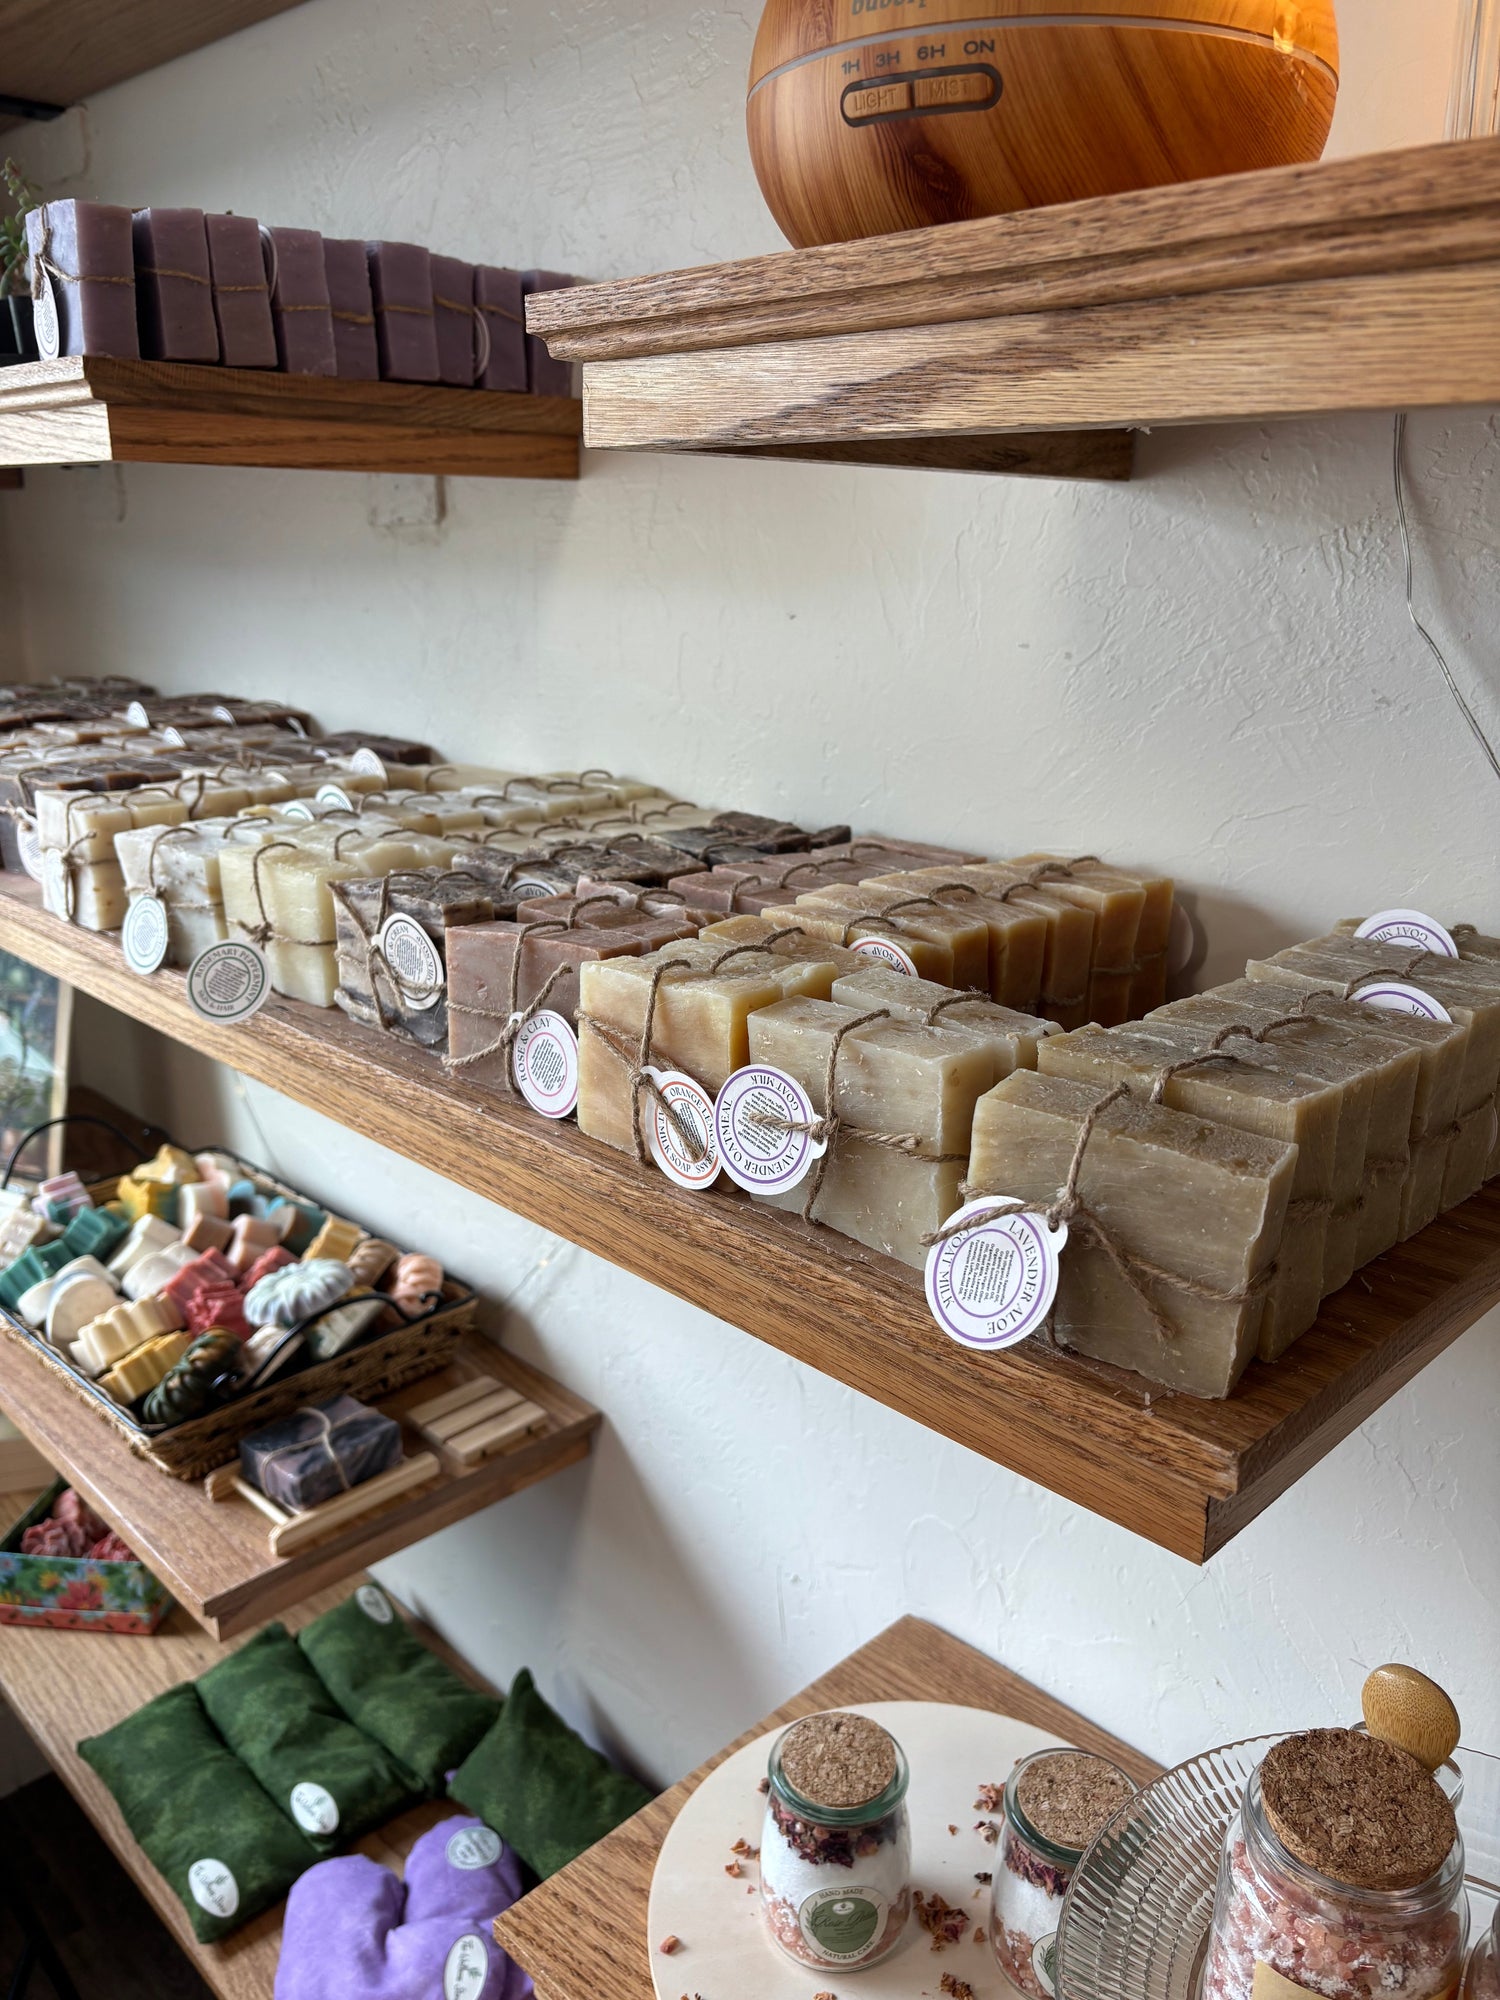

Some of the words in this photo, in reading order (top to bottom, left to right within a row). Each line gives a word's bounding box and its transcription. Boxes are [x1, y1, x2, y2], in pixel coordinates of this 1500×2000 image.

[841, 58, 860, 74] 1H
[876, 51, 900, 67] 3H
[917, 44, 945, 60] 6H
[964, 40, 995, 54] ON
[854, 88, 896, 111] LIGHT
[930, 79, 971, 98] MIST
[390, 925, 409, 941] CREAM
[1396, 926, 1428, 942] GOAT
[872, 946, 894, 961] SOAP
[527, 1016, 551, 1035] CLAY
[520, 1034, 529, 1045] &
[515, 1044, 527, 1082] ROSE
[750, 1074, 774, 1085] MILK
[669, 1087, 704, 1108] ORANGE
[774, 1082, 800, 1111] GOAT
[718, 1099, 742, 1163] OATMEAL
[658, 1125, 672, 1154] MILK
[669, 1152, 691, 1173] SOAP
[743, 1142, 800, 1176] LAVENDER
[943, 1229, 970, 1264] GOAT
[1008, 1220, 1038, 1303] LAVENDER
[939, 1271, 954, 1309] MILK
[986, 1302, 1023, 1335] ALOE
[819, 1889, 841, 1899] HAND
[842, 1888, 864, 1896] MADE
[822, 1949, 858, 1960] NATURAL
[857, 1940, 875, 1956] CARE
